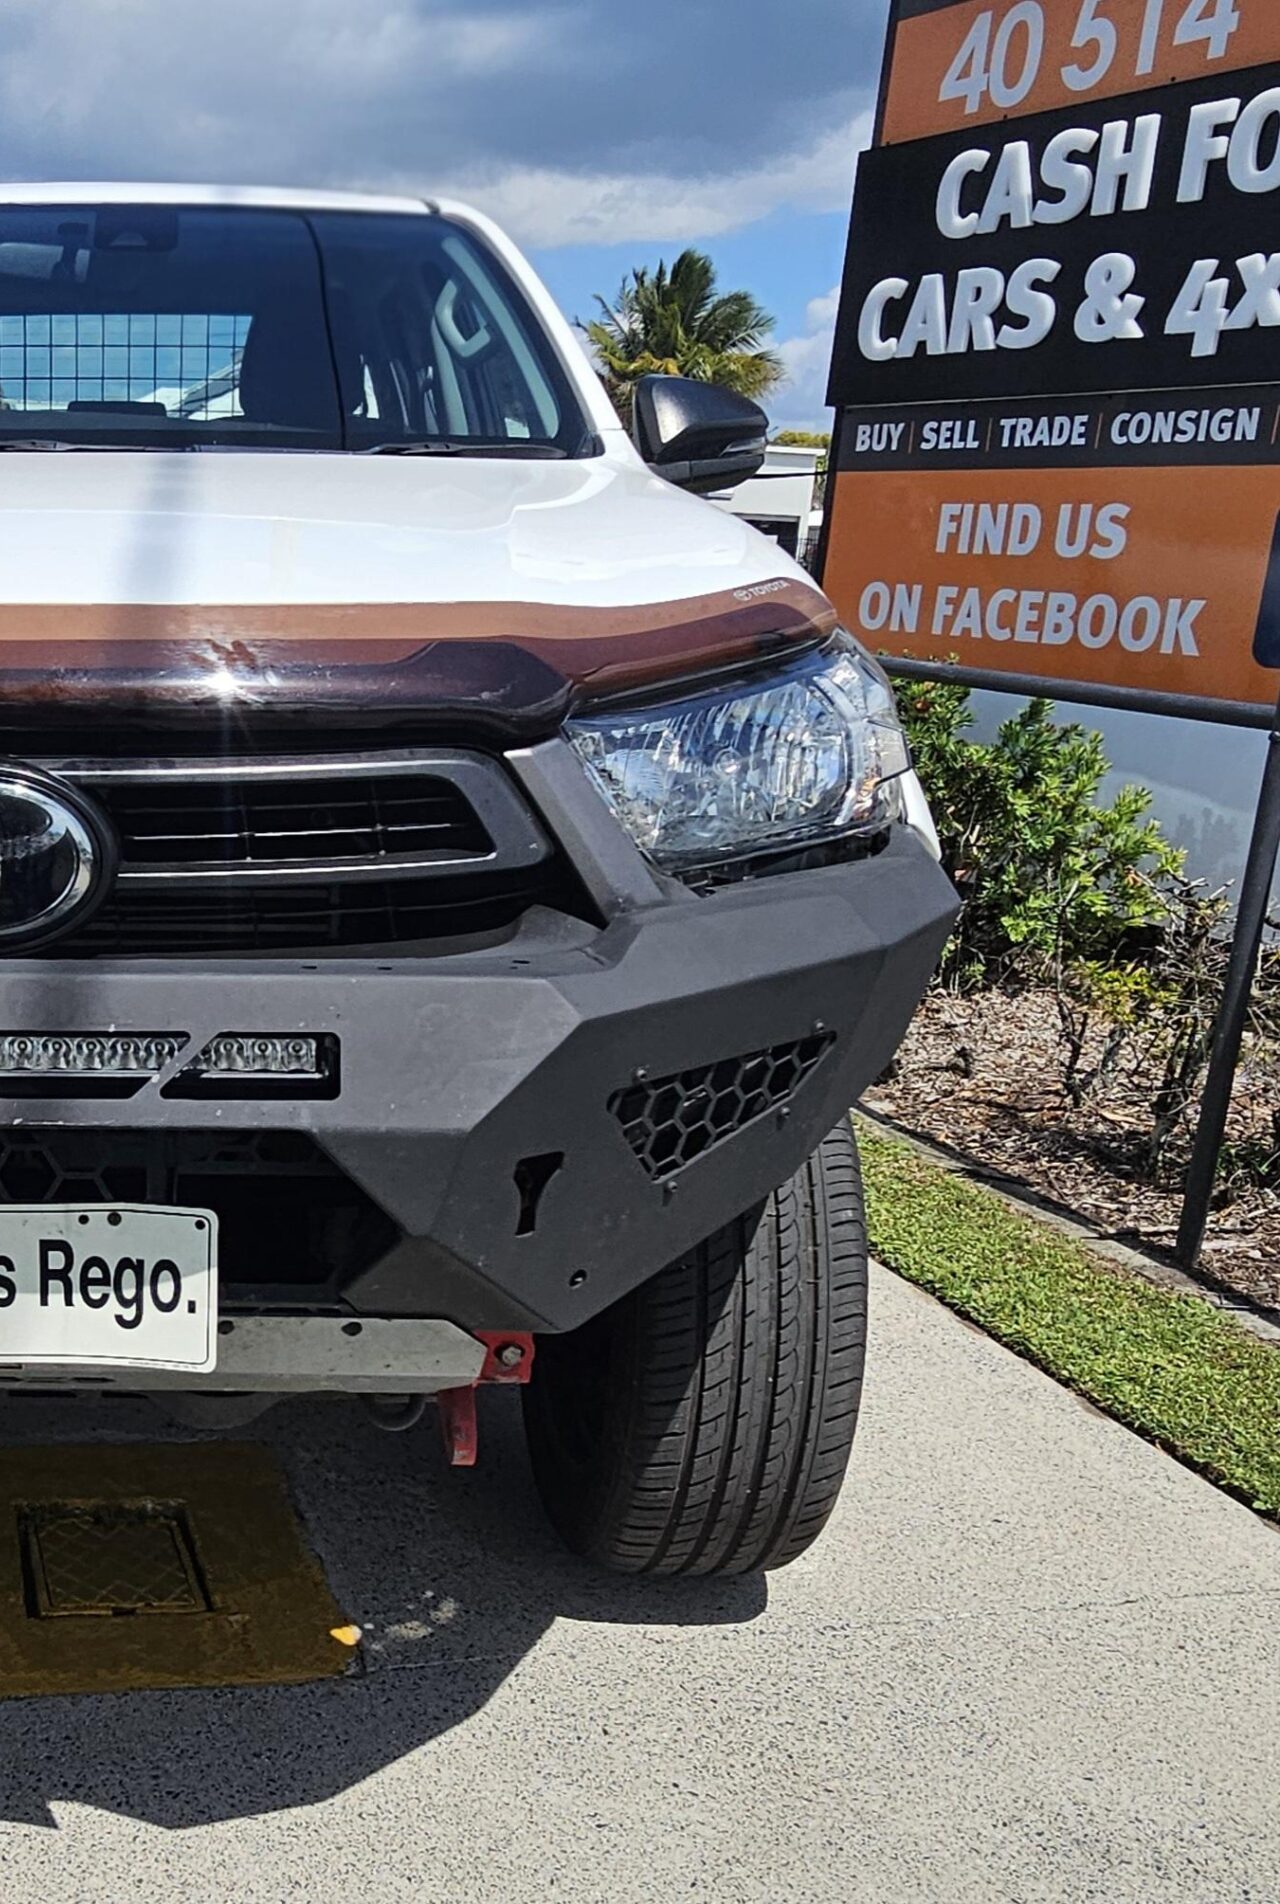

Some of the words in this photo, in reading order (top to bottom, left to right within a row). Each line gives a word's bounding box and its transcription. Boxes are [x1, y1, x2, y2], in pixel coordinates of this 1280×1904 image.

[938, 0, 1045, 115] 40
[935, 113, 1162, 239] CASH
[858, 257, 1062, 361] CARS
[1073, 252, 1145, 343] &
[855, 422, 904, 452] BUY
[920, 420, 979, 450] SELL
[999, 414, 1089, 447] TRADE
[1110, 407, 1260, 445] CONSIGN
[935, 503, 1042, 556] FIND
[1054, 502, 1131, 560] US
[748, 580, 791, 597] TOYOTA
[858, 581, 923, 633] ON
[931, 585, 1207, 657] FACEBOOK
[38, 1239, 197, 1330] Rego.
